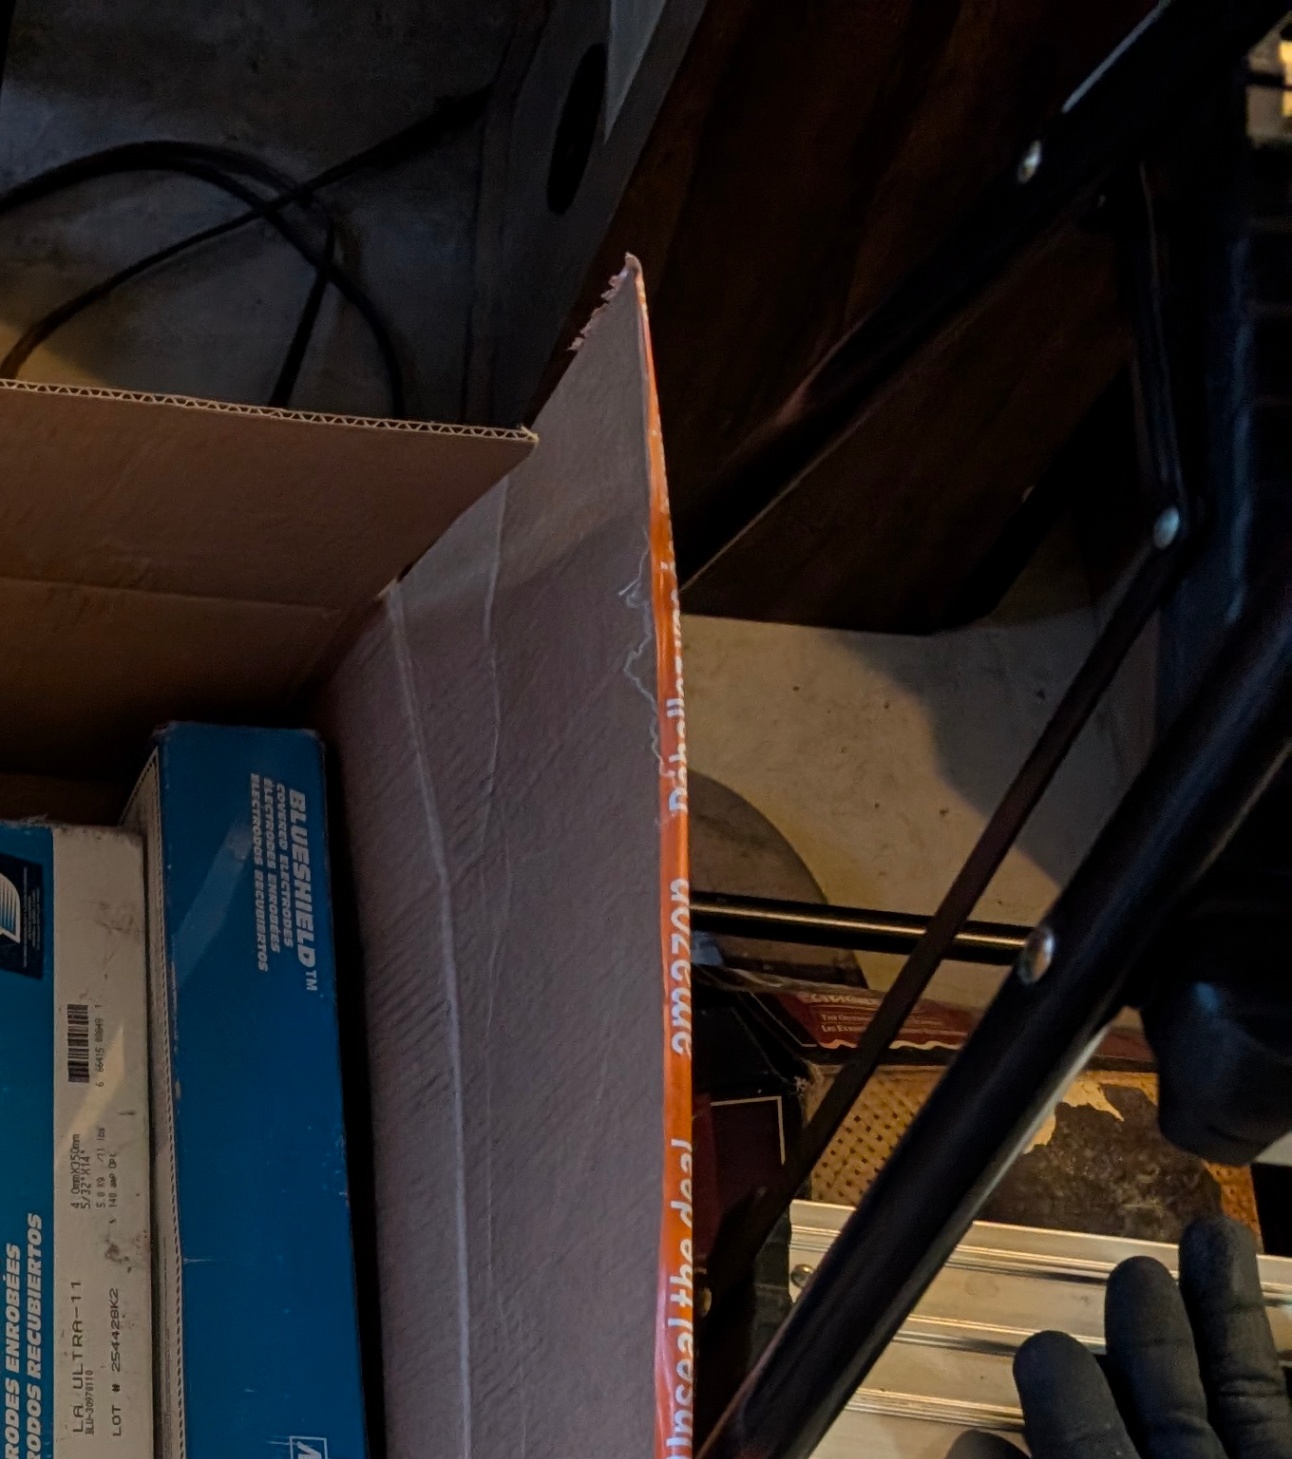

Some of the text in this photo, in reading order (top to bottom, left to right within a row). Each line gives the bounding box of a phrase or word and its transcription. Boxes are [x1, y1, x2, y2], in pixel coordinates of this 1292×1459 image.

[250, 773, 264, 867] ELECTRODOS
[276, 782, 294, 948] COVERED ELECTRODES
[2, 1241, 22, 1373] ENROBÉES
[26, 1212, 43, 1380] RECUBIERTOS
[70, 1281, 85, 1433] LA ULTRA-11
[112, 1404, 122, 1437] LOT
